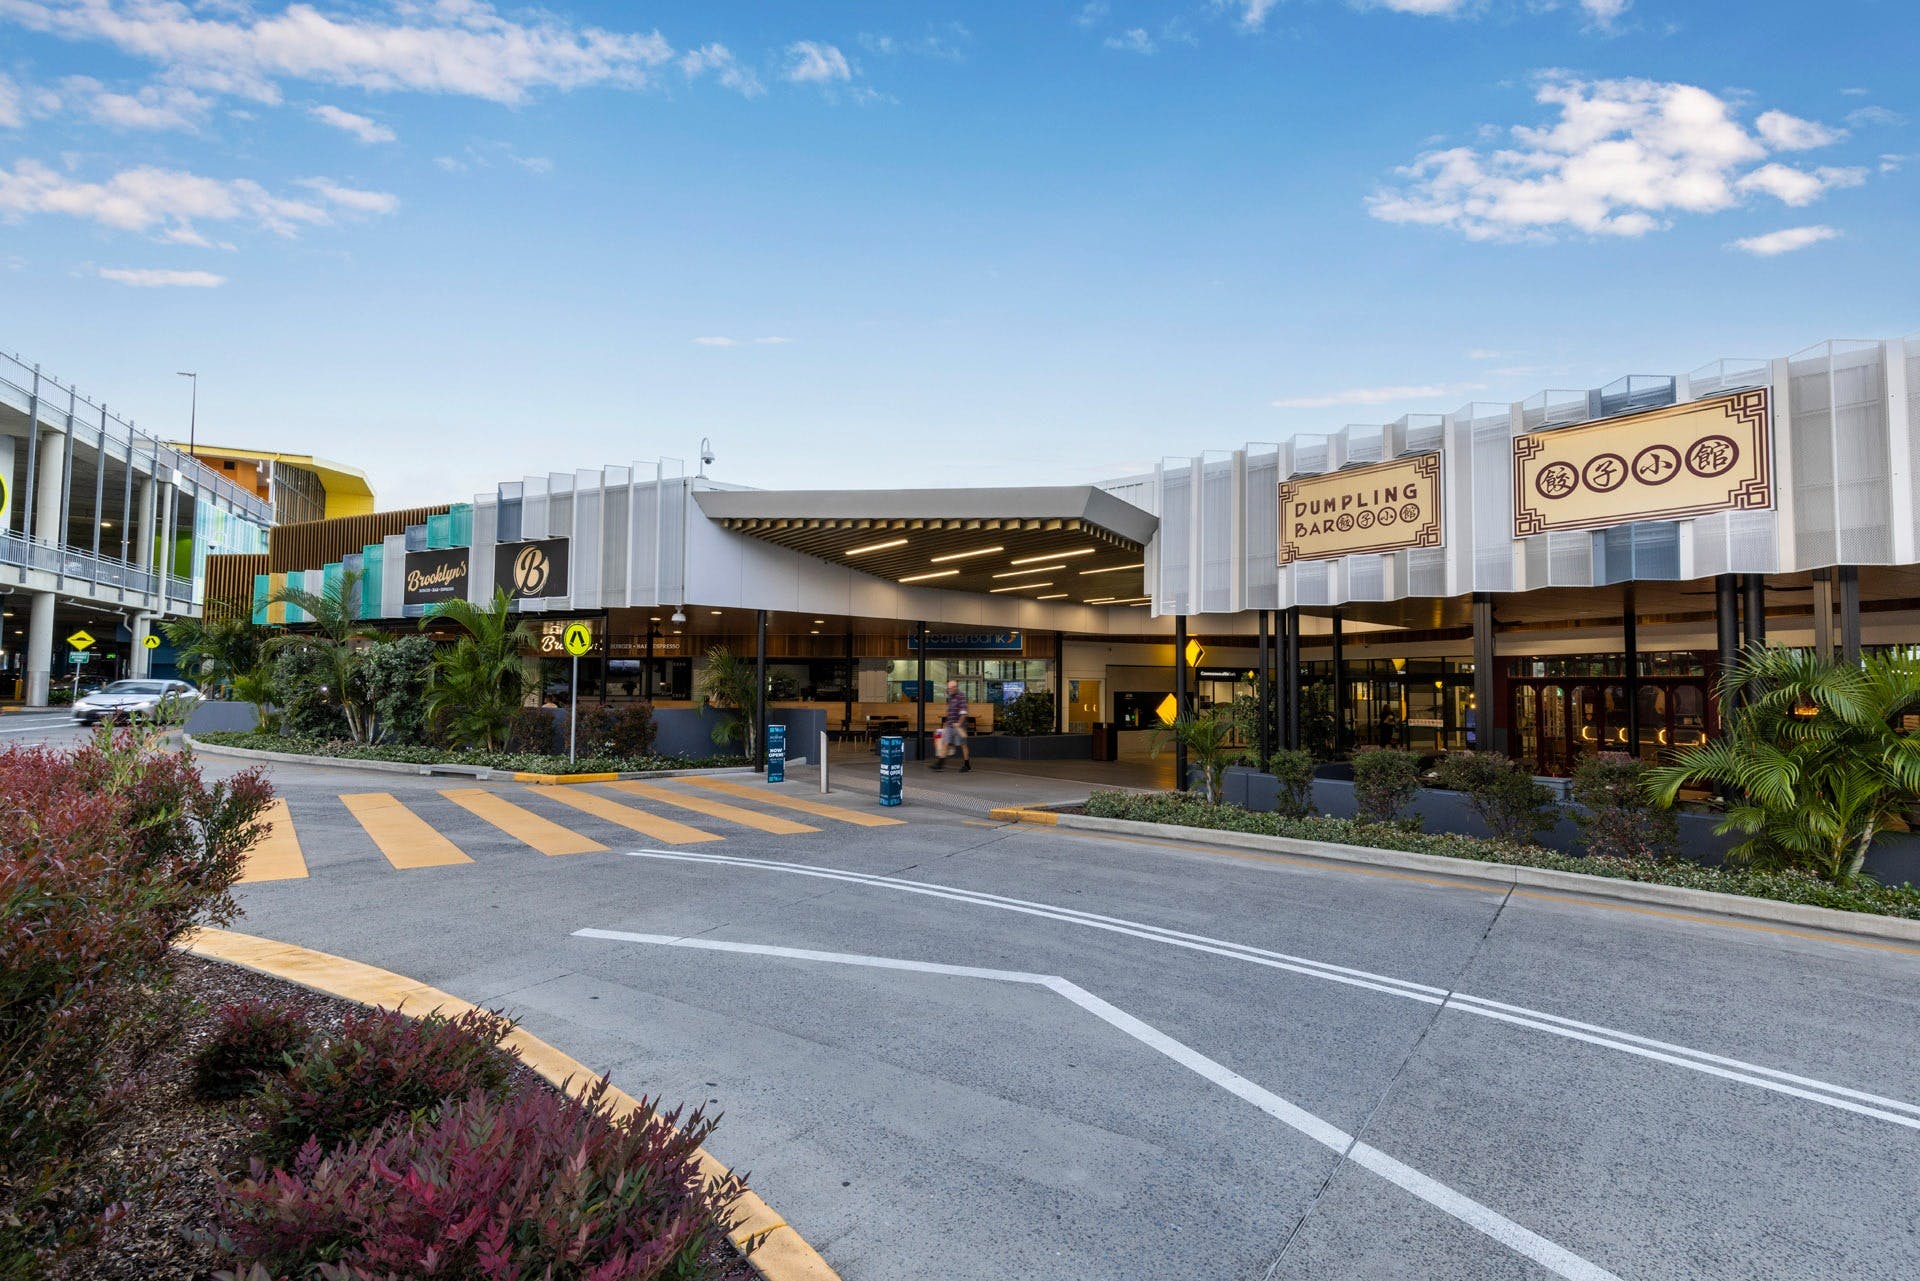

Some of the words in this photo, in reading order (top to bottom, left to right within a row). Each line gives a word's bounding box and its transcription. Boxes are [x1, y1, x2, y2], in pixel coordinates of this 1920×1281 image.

[1539, 439, 1732, 496] 餃子小館
[1295, 483, 1418, 518] DUMPLING
[1295, 519, 1335, 538] BAR
[407, 560, 467, 592] Brooklyn's
[519, 548, 546, 593] B
